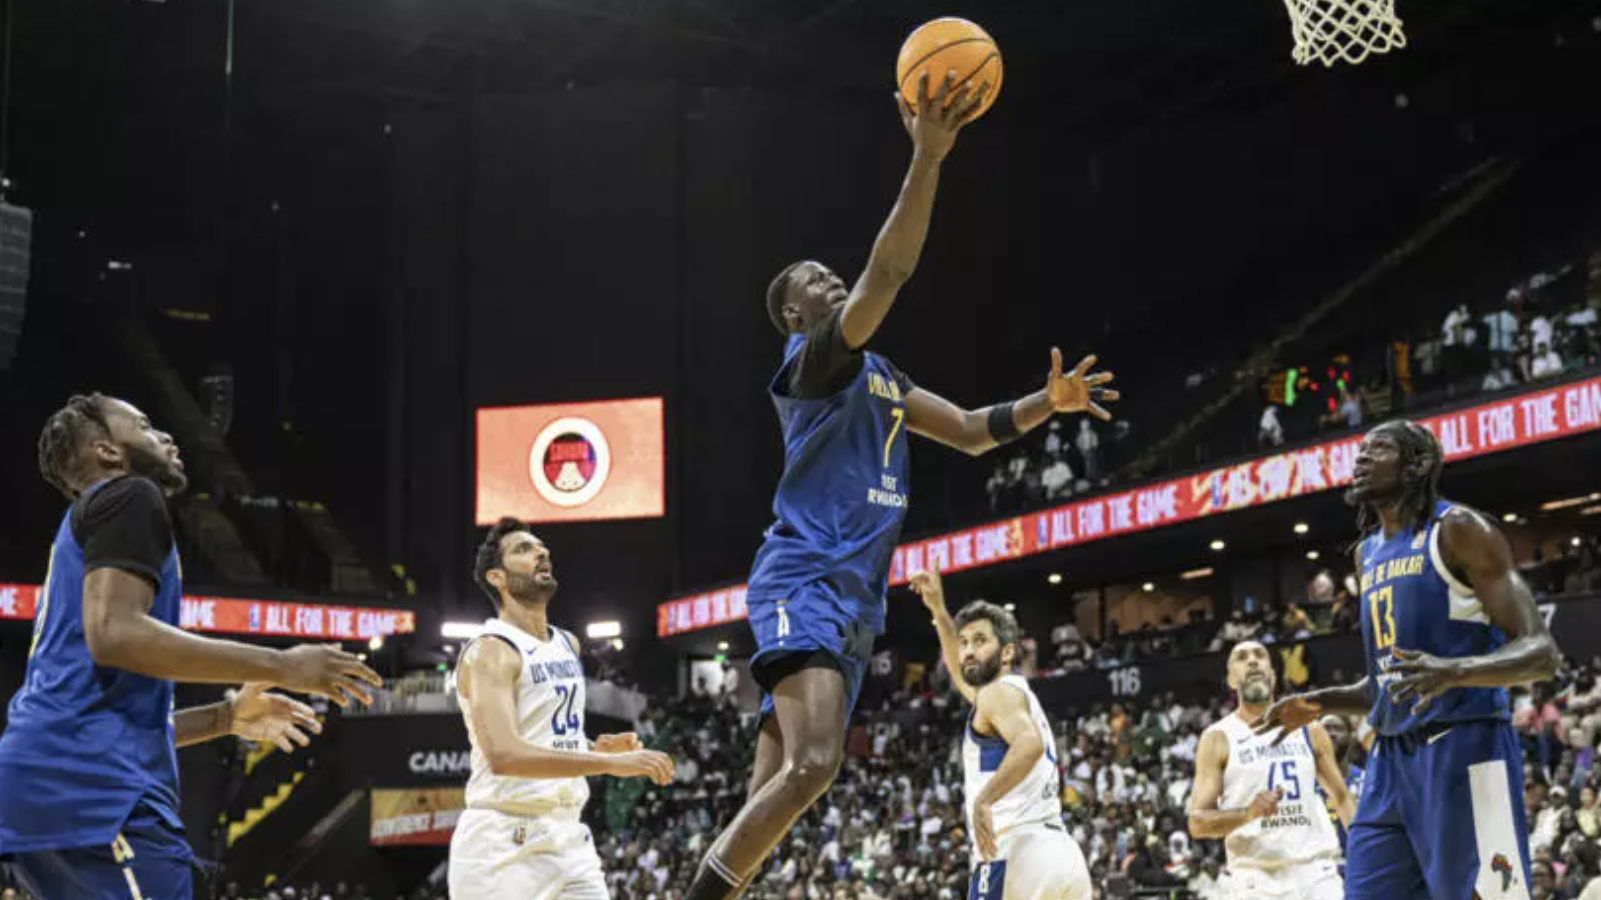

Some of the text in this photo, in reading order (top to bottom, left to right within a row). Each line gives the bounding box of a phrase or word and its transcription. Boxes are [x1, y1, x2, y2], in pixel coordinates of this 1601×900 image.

[884, 406, 904, 469] 7
[1440, 415, 1472, 455] ALL
[1478, 405, 1514, 446] FOR
[1520, 393, 1559, 438] THE
[1051, 484, 1178, 546] ALL FOR THE GAME
[265, 603, 291, 633] ALL
[295, 606, 323, 634] FOR
[327, 608, 354, 637] THE
[1368, 586, 1397, 650] 13
[551, 683, 579, 736] 24
[1108, 667, 1141, 696] 116
[409, 751, 471, 772] CANA
